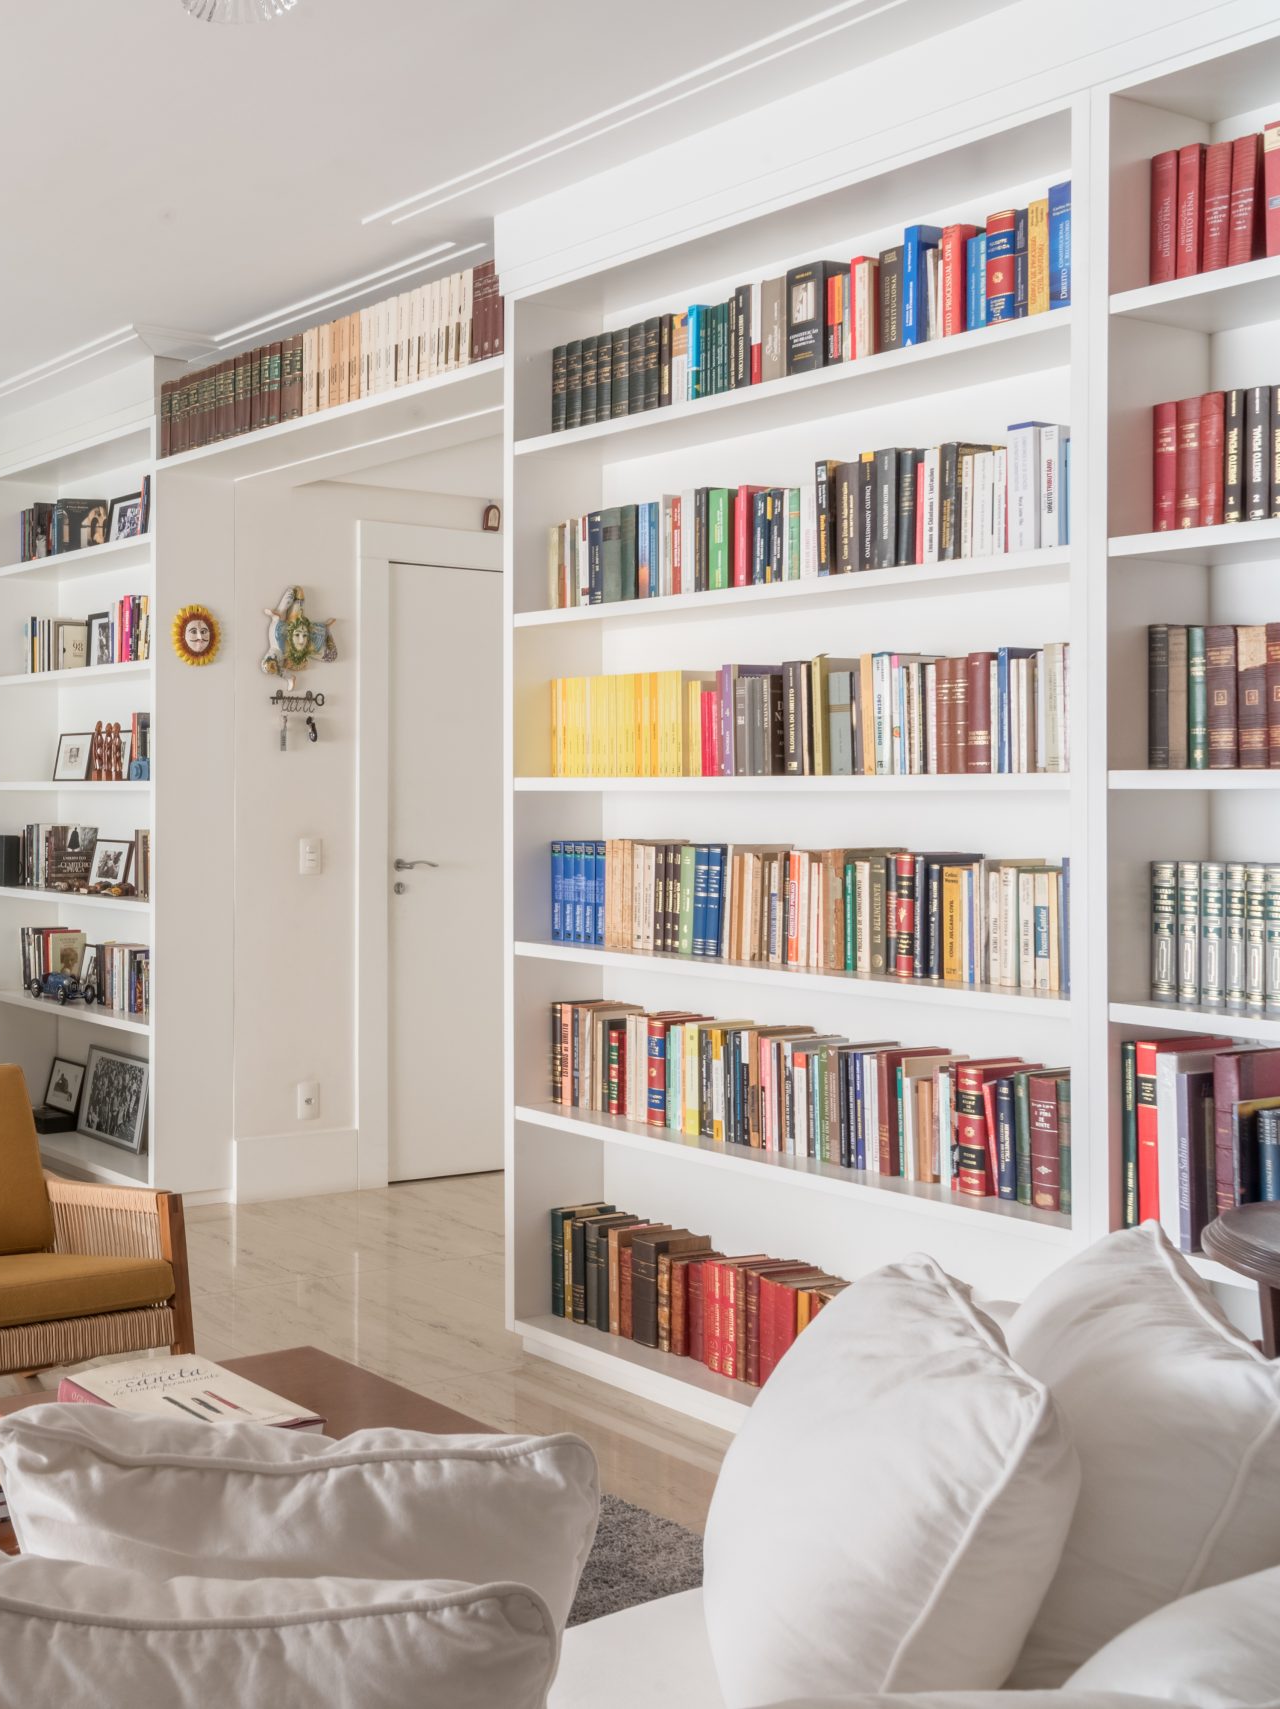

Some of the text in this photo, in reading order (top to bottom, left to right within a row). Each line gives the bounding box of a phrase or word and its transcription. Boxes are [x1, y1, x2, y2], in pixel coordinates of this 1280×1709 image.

[1162, 196, 1170, 257] DIREITO PENAL
[1185, 191, 1193, 252] DIREITO PENAL
[1059, 268, 1068, 299] DIREITO
[883, 307, 890, 317] DE
[889, 274, 897, 341] CONSTITUCIONAL
[1228, 427, 1238, 454] PENAL
[1252, 425, 1262, 452] PENAL
[1228, 454, 1238, 485] DIREITO
[1252, 452, 1262, 483] DIREITO
[1252, 494, 1262, 503] 2
[72, 642, 84, 652] 98
[789, 714, 795, 723] DO
[873, 883, 881, 943] EL DELINCUENTE
[1037, 908, 1048, 956] Processo Cautelar
[1178, 1137, 1189, 1210] Horácio Sabino
[125, 1368, 201, 1389] caneta
[129, 1384, 159, 1394] tinta
[161, 1373, 220, 1391] permanente
